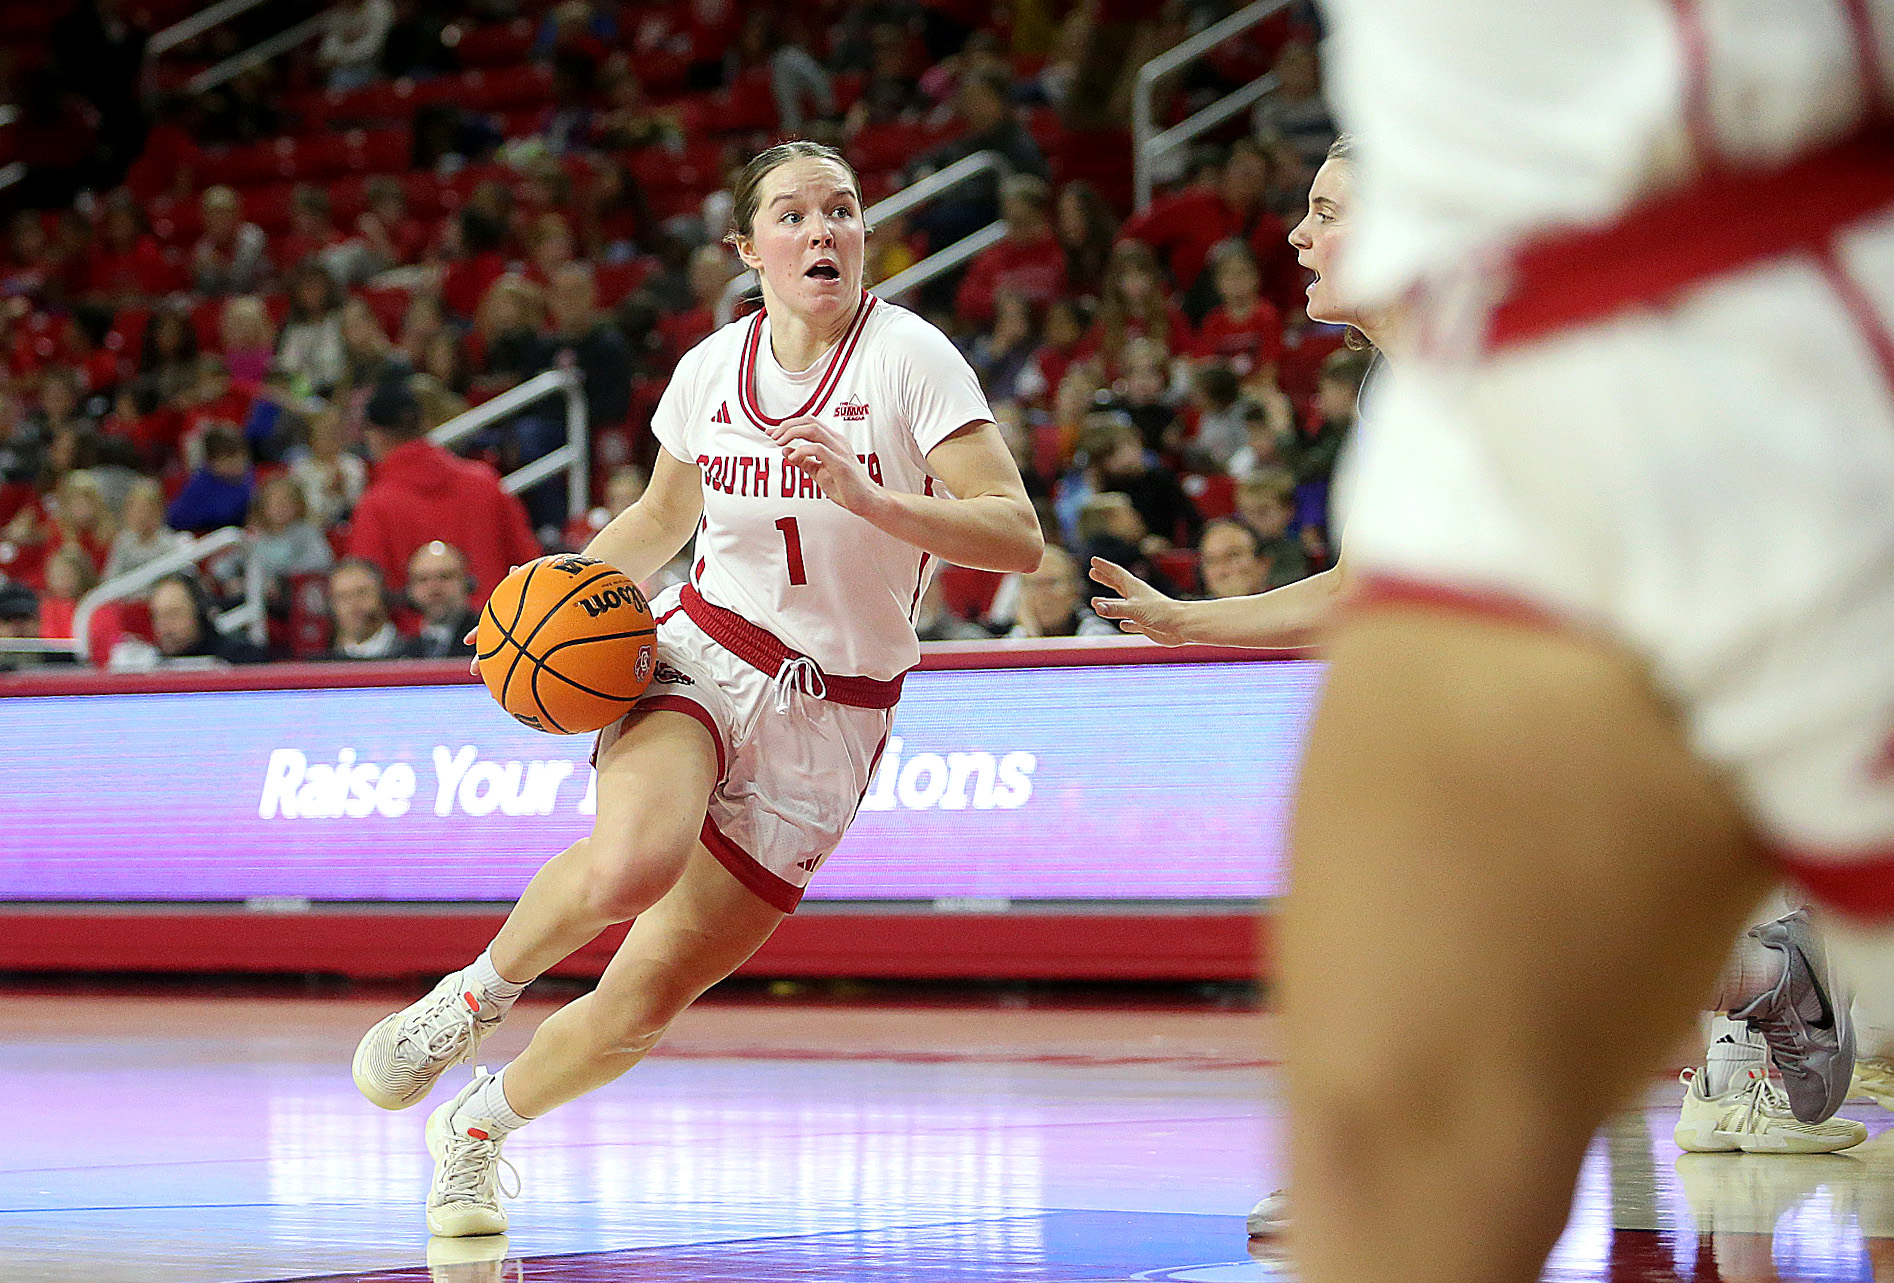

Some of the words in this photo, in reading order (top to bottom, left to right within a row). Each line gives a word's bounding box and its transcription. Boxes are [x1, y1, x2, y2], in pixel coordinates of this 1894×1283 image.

[696, 454, 770, 498] SOUTH
[775, 516, 808, 587] 1
[258, 747, 417, 820] Raise
[432, 744, 574, 817] Your
